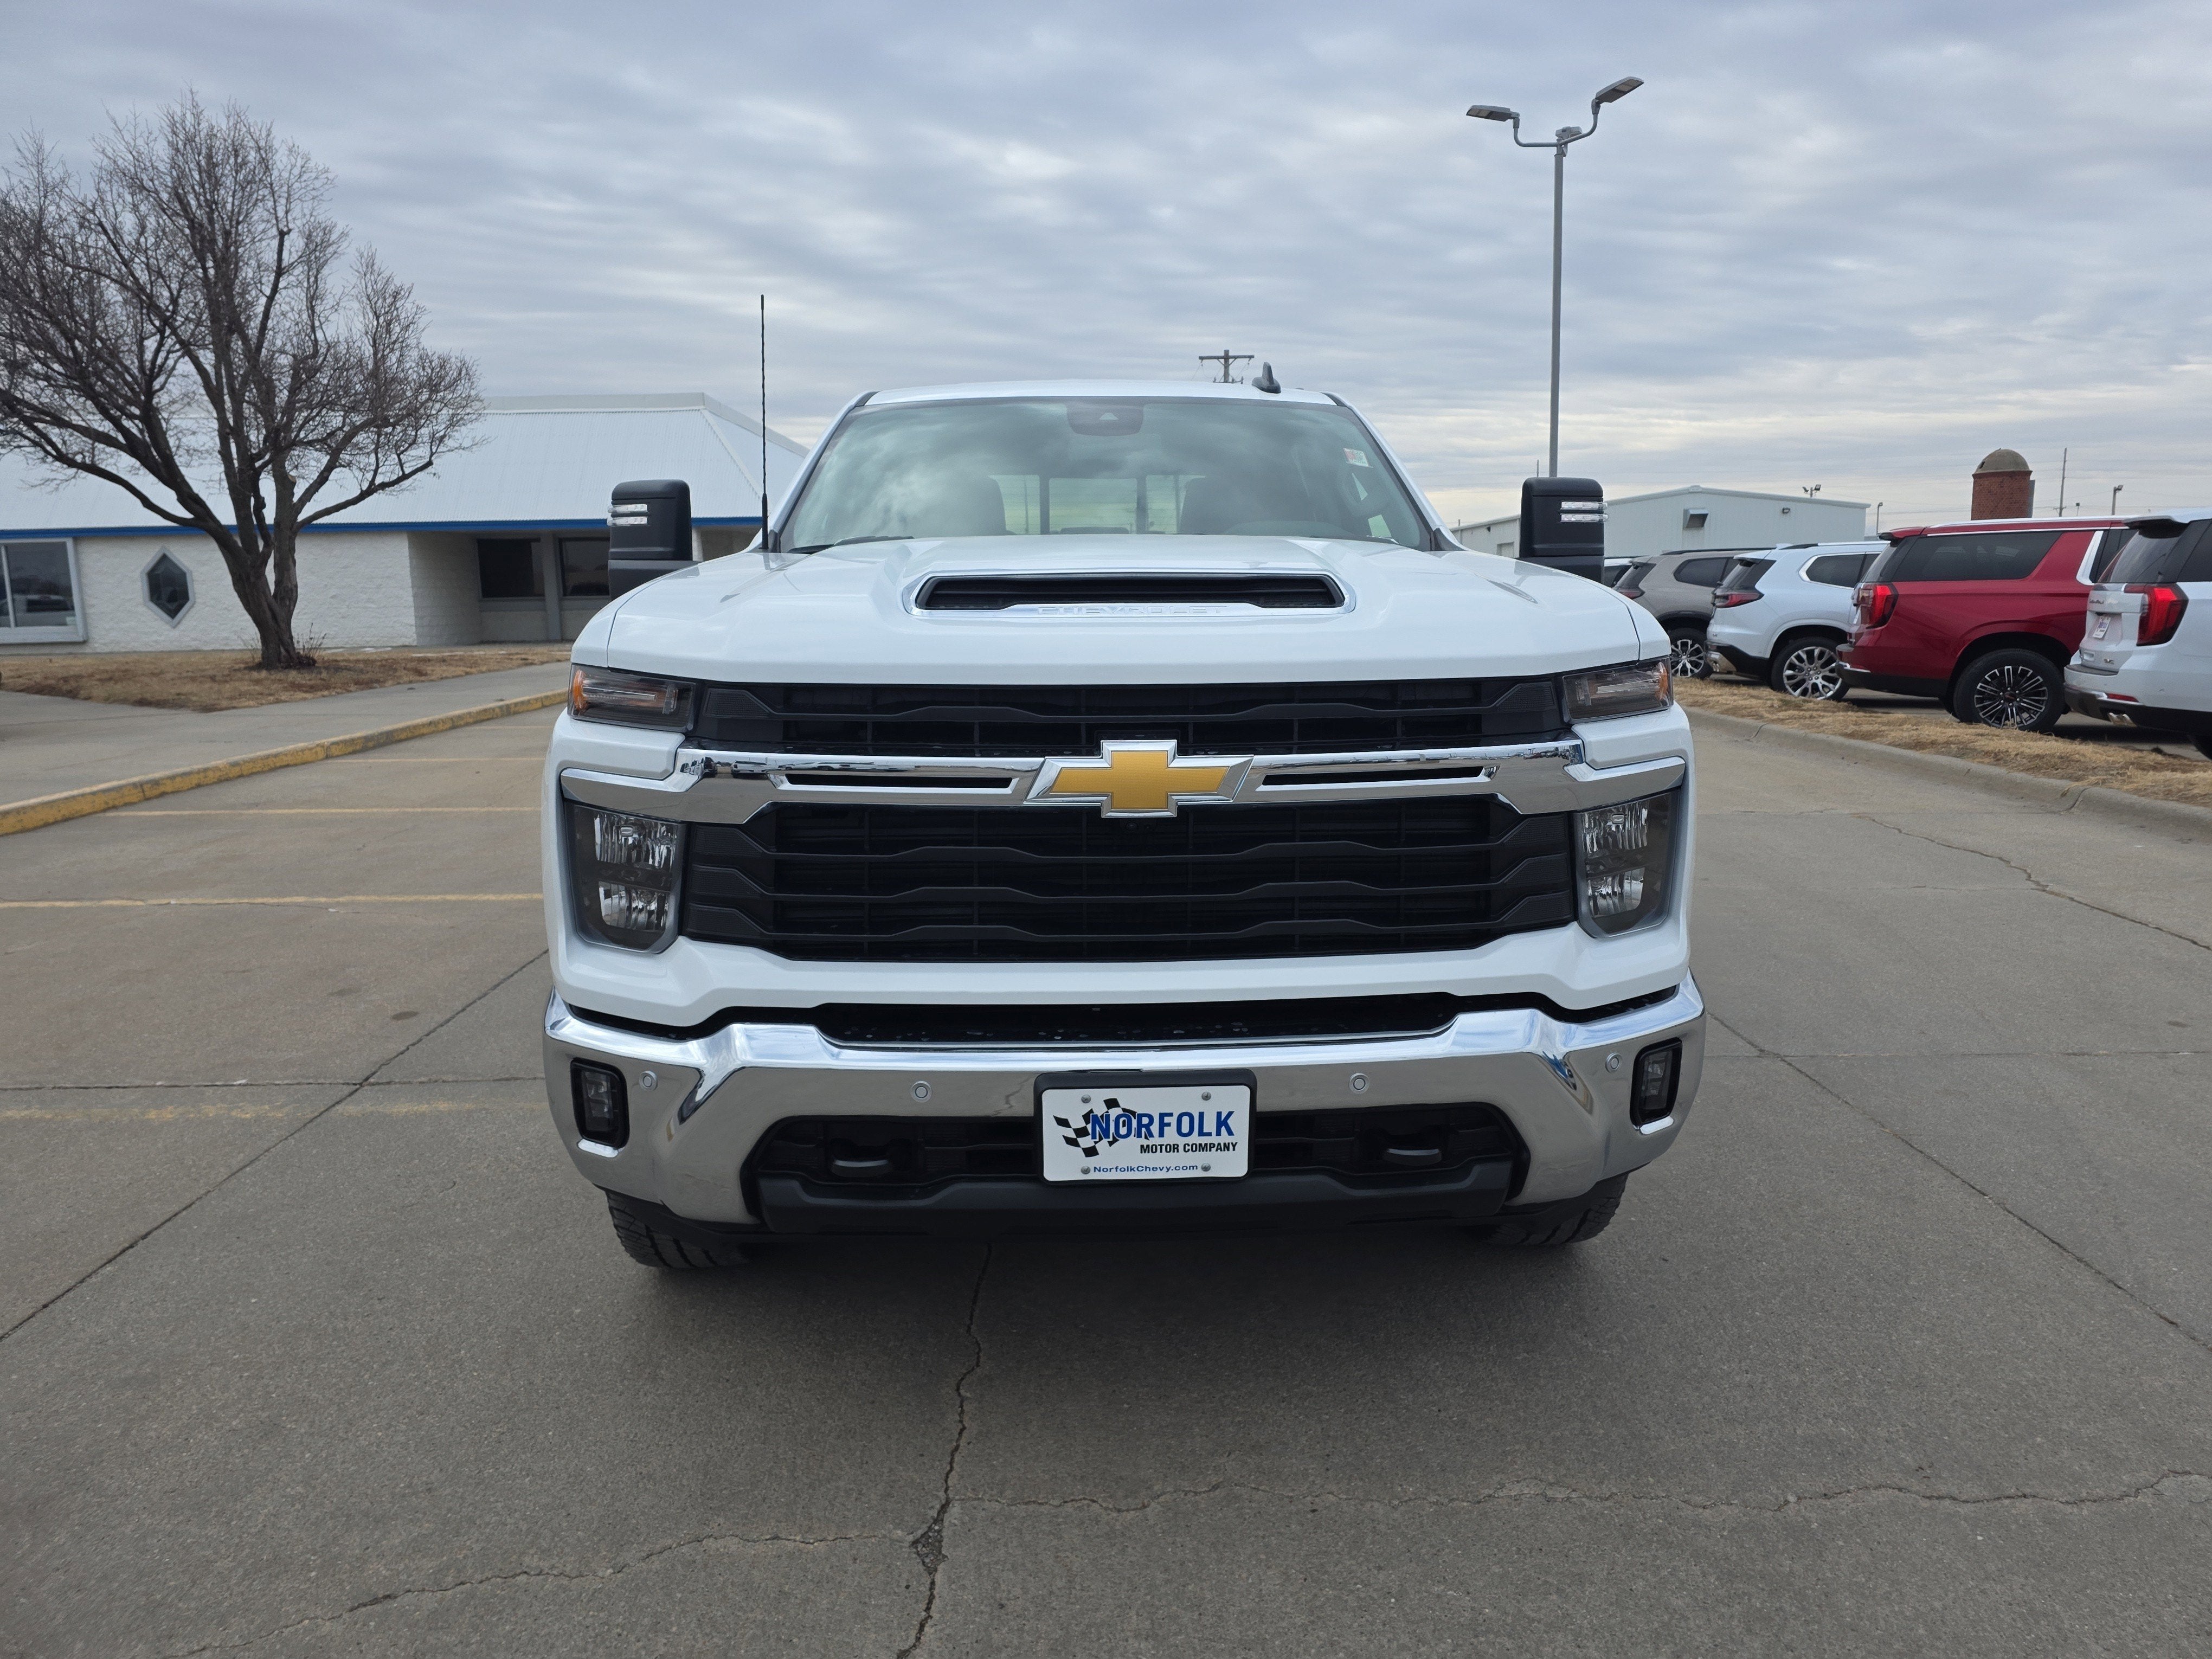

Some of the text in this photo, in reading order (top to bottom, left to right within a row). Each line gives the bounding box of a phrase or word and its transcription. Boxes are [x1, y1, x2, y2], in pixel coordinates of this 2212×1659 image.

[1038, 606, 1227, 615] CHEVROLET
[1091, 1111, 1234, 1140] NORFOLK
[1140, 1142, 1238, 1154] MOTOR COMPANY
[1094, 1164, 1198, 1173] NorfolkChevy.com
